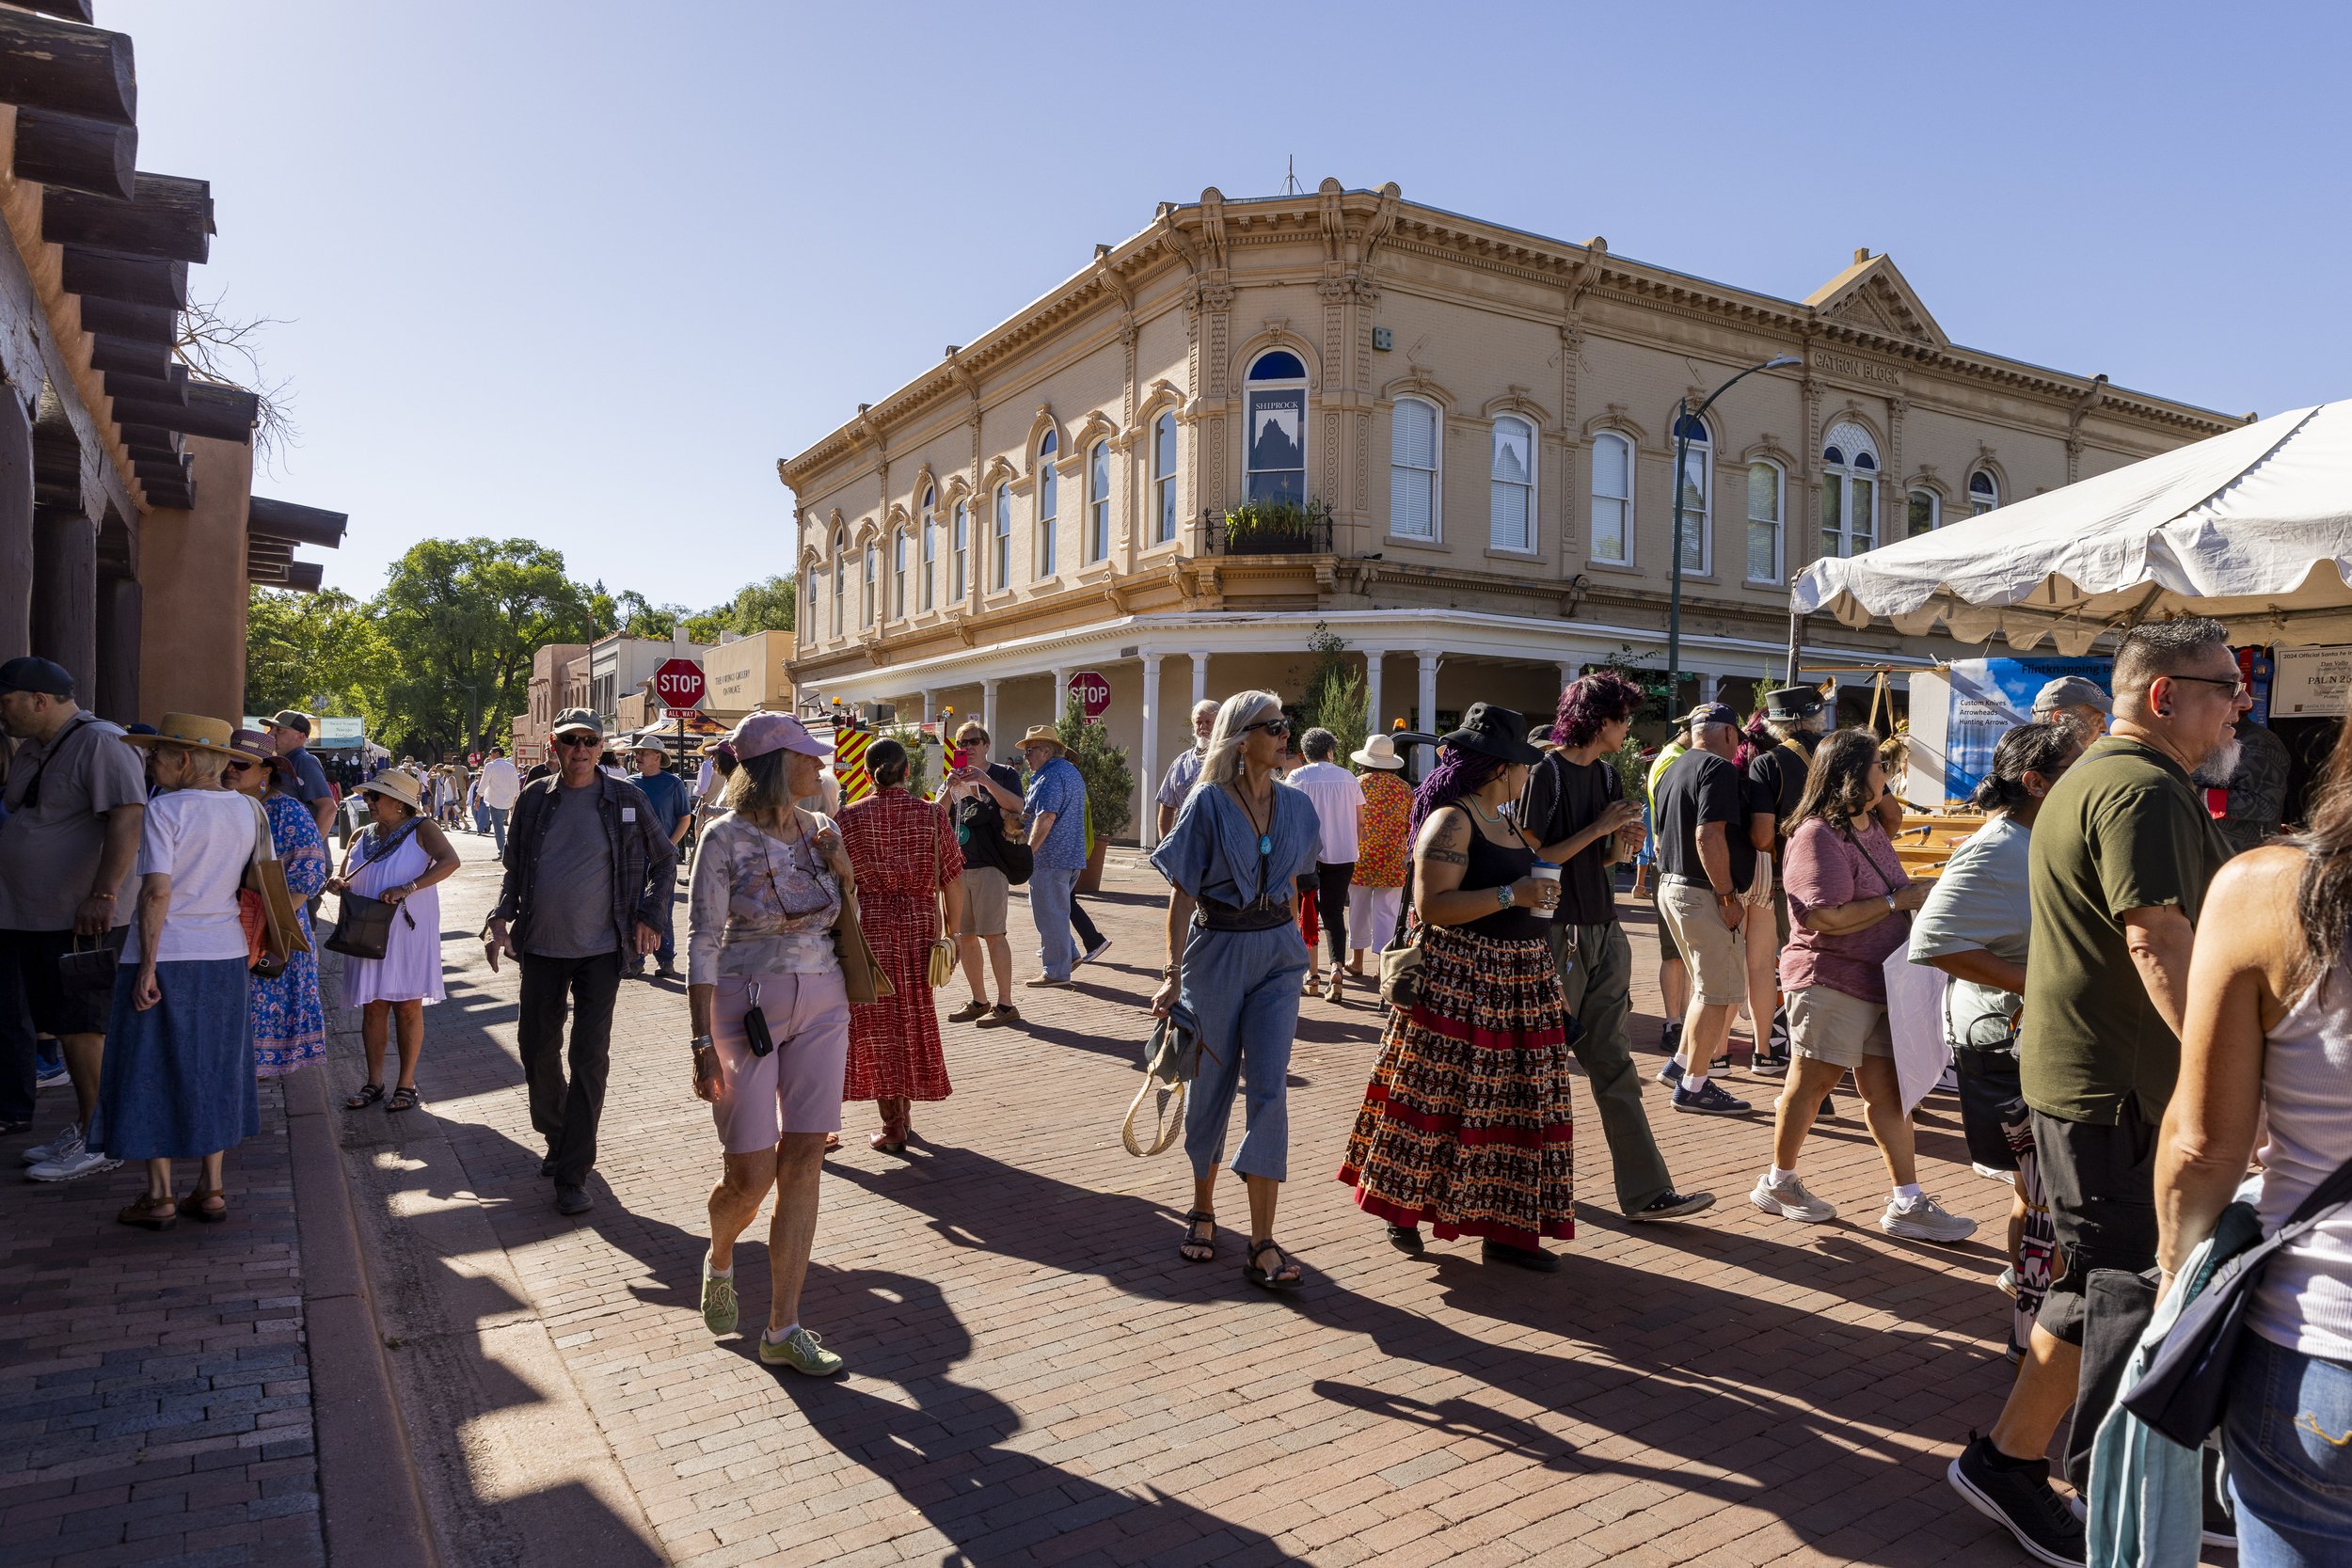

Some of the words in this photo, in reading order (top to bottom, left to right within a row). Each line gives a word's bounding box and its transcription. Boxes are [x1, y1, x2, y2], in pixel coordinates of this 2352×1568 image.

[1815, 352, 1859, 375] CATRON
[1864, 363, 1899, 385] BLOCK
[736, 670, 750, 681] GALLERY
[2022, 663, 2099, 675] Flintknapping
[660, 674, 702, 693] STOP
[1071, 687, 1108, 704] STOP
[1985, 698, 2007, 706] Knives
